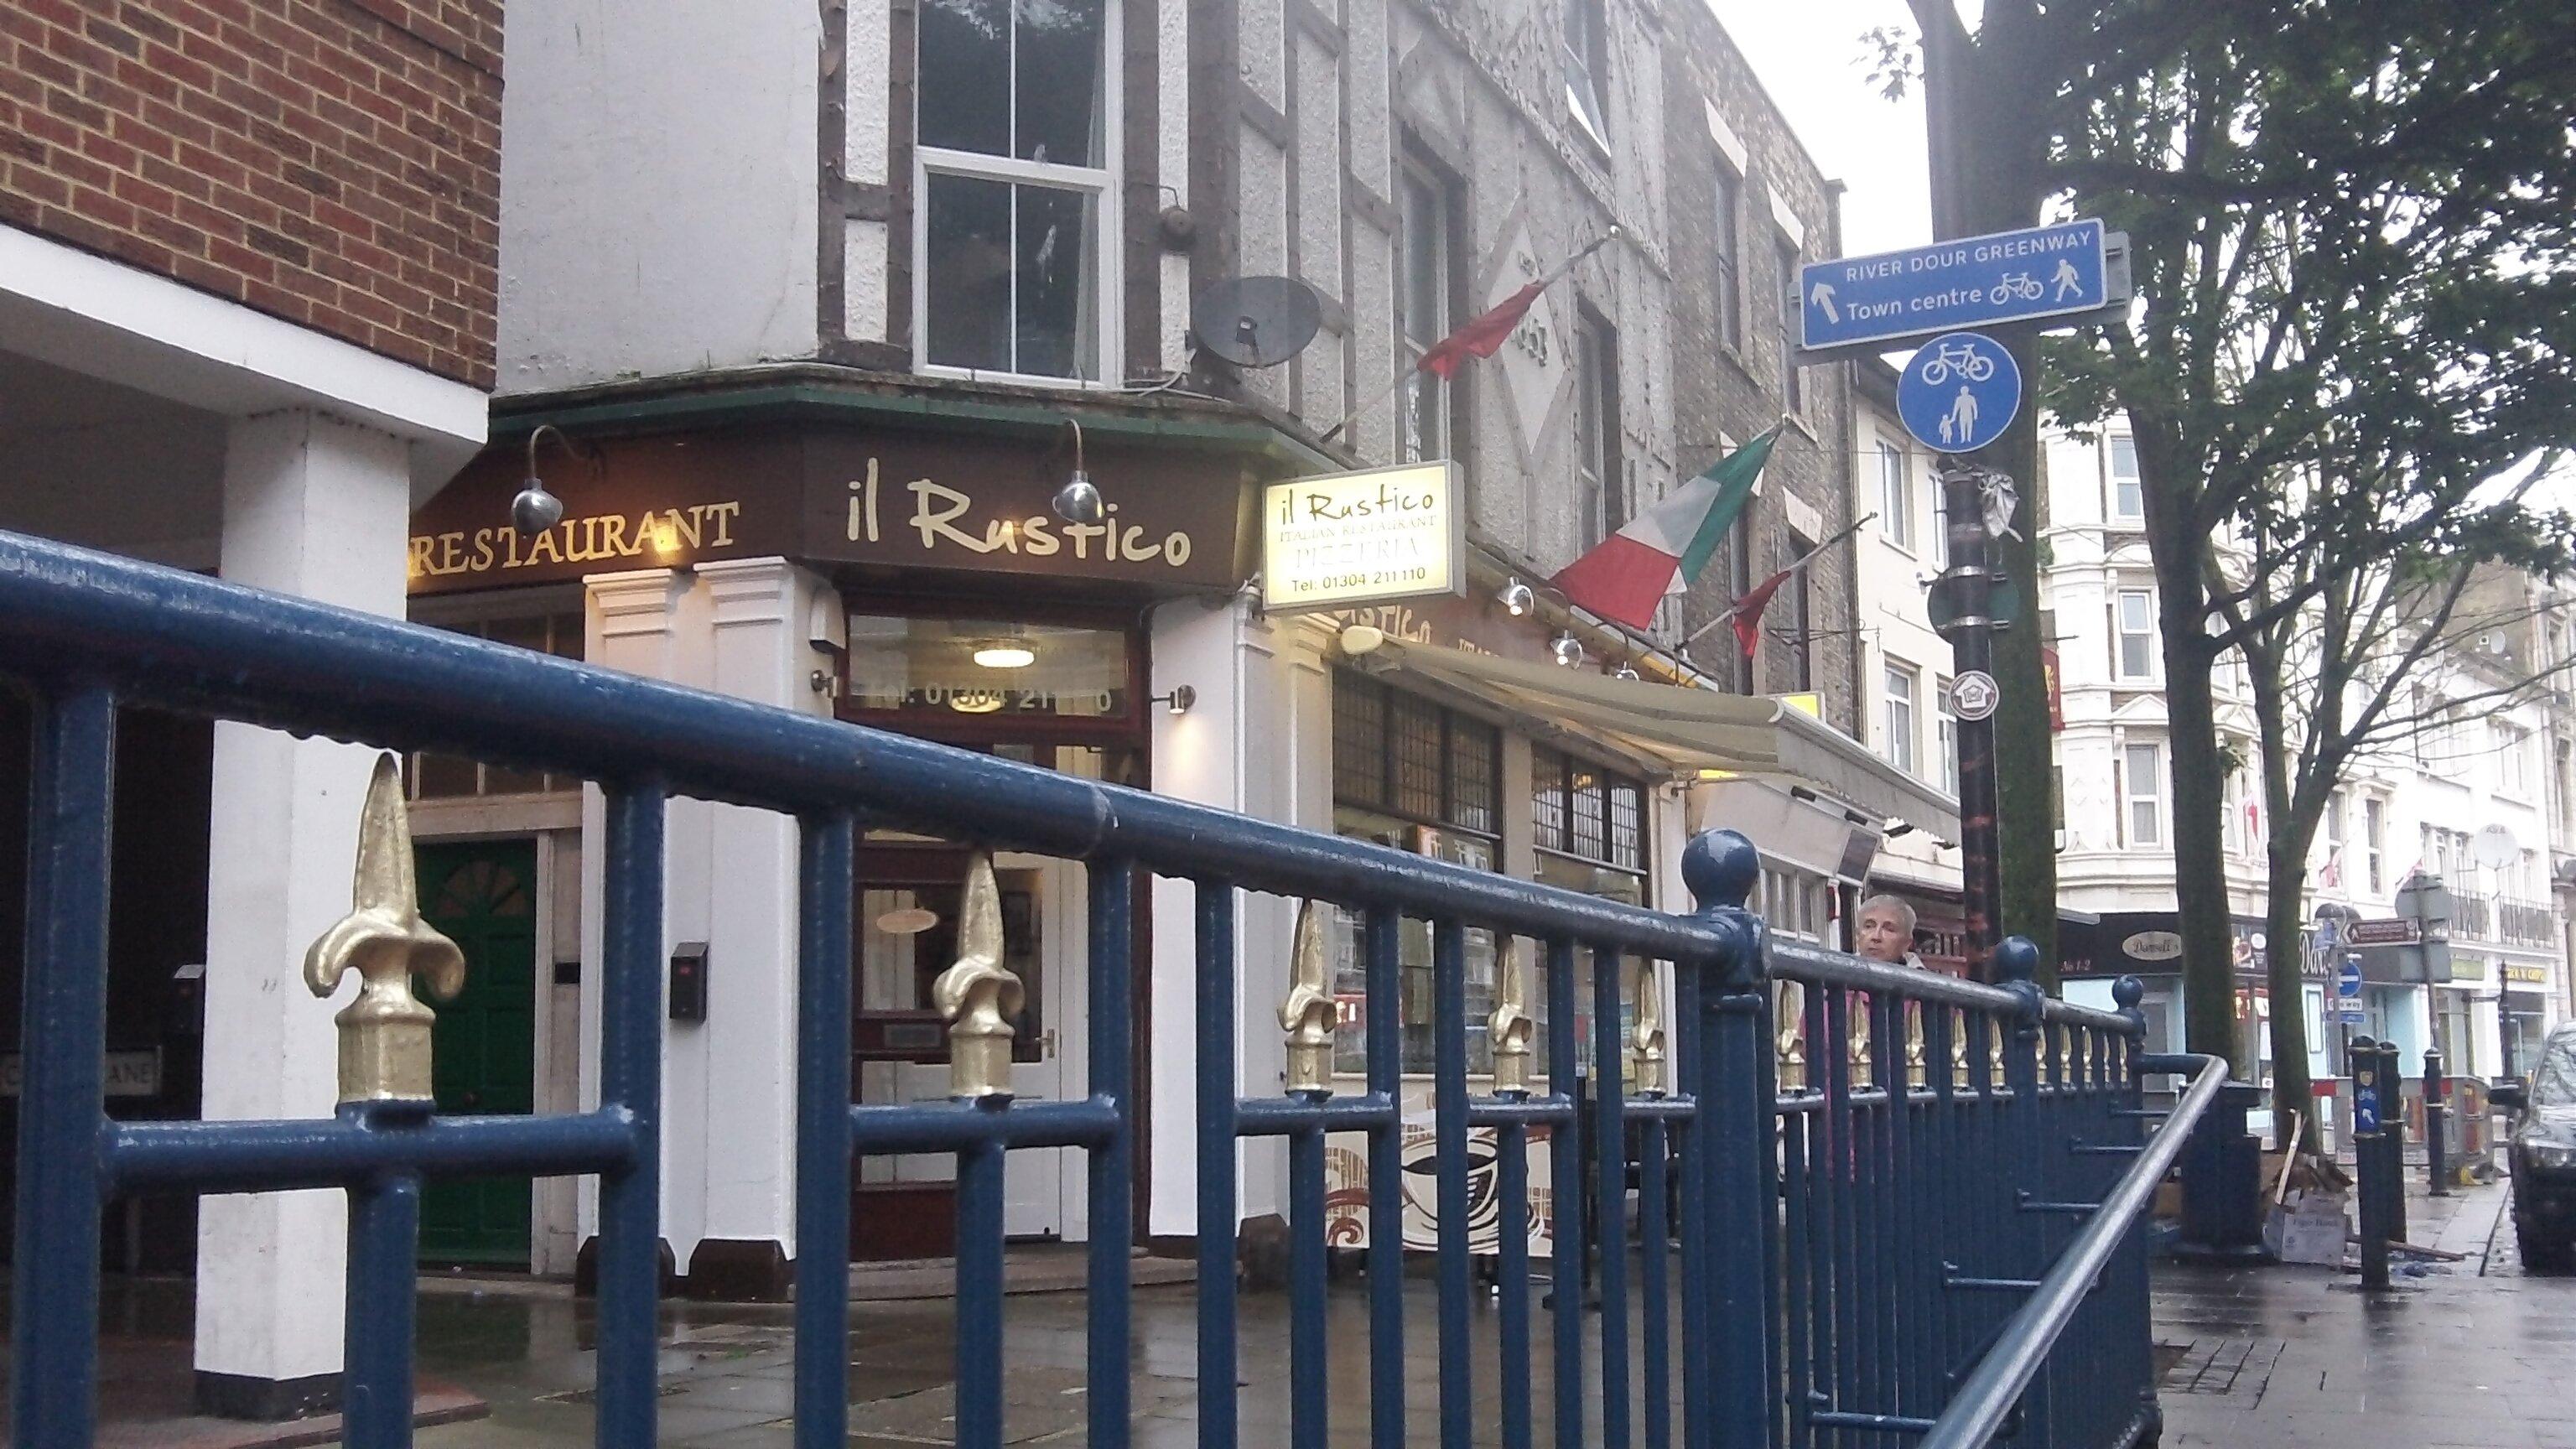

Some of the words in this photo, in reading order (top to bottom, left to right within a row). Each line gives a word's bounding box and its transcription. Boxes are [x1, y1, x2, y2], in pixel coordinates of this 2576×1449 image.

[1846, 260, 1903, 282] RIVER
[1911, 250, 1967, 270] DOUR
[1975, 230, 2091, 262] GREENWAY
[1846, 300, 1903, 321] Town
[1910, 288, 1983, 311] centre
[848, 457, 879, 543] il
[906, 478, 1192, 568] Rustico
[1282, 488, 1294, 526] il
[1306, 483, 1434, 522] Rustico
[408, 501, 741, 577] RESTAURANT
[1322, 574, 1366, 589] 01304
